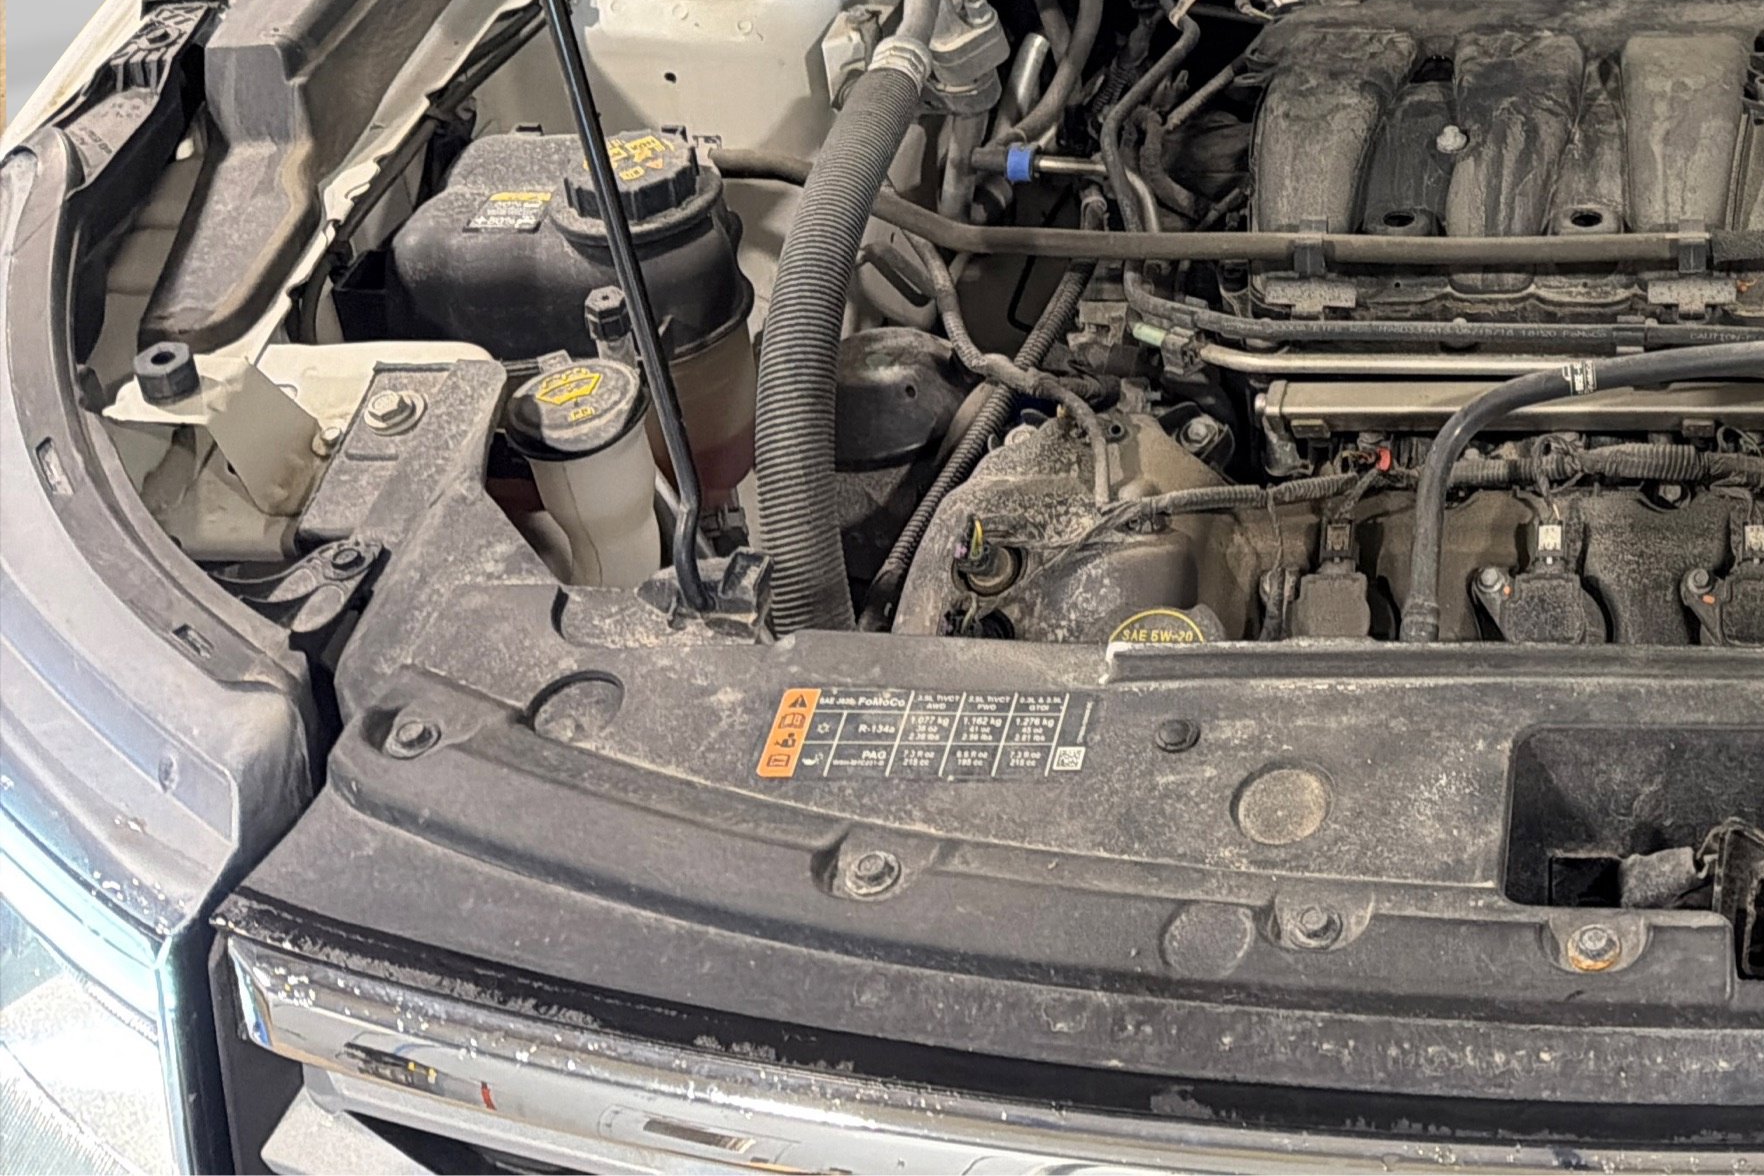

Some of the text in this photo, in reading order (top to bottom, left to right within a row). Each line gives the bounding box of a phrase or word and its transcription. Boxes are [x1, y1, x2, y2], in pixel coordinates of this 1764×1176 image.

[1122, 628, 1194, 642] SAE 5W-20
[858, 696, 906, 708] FoMoCo
[910, 715, 950, 728] 1.077 kg
[963, 716, 1003, 728] 1.162 kg
[1041, 717, 1055, 728] kg
[858, 723, 896, 734] R-134a
[861, 750, 887, 760] PAG
